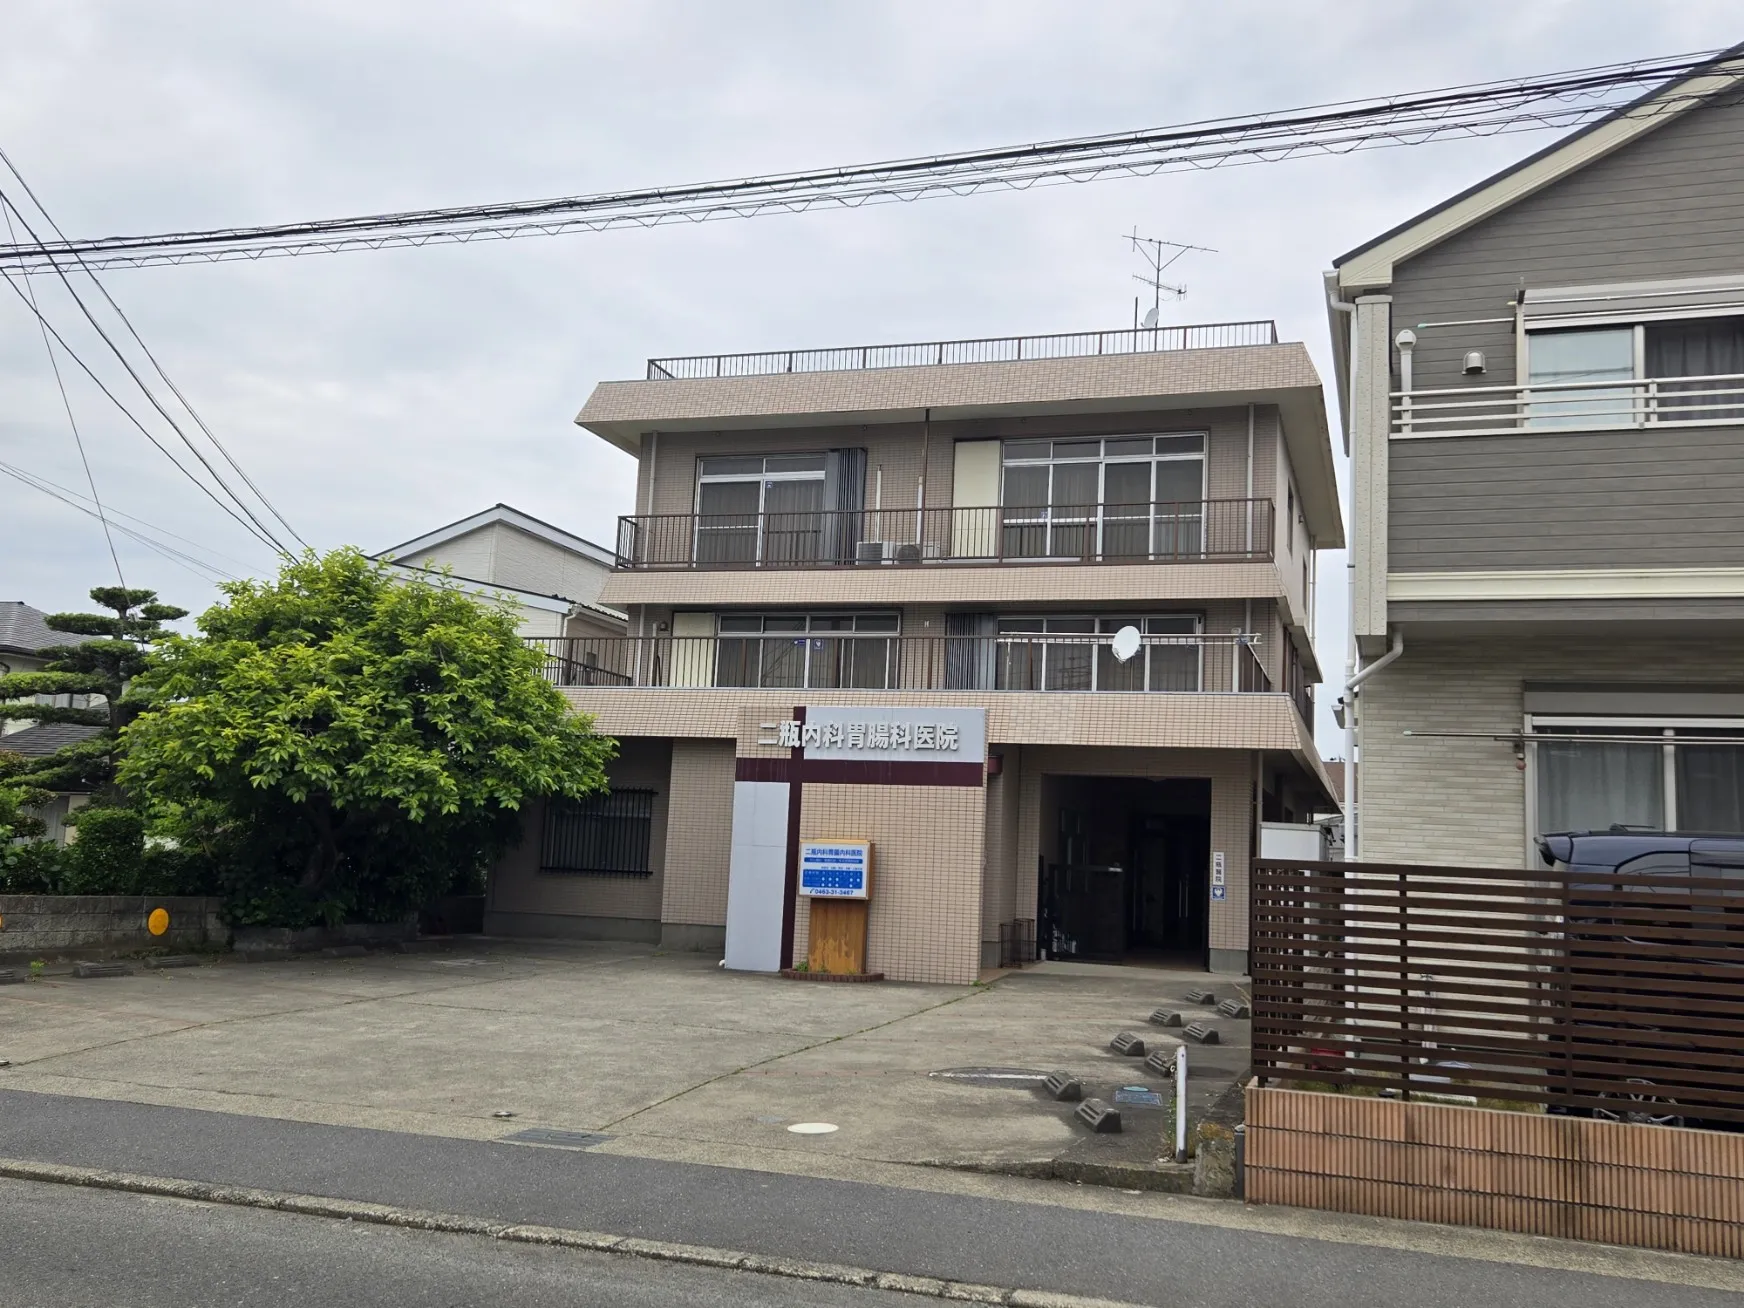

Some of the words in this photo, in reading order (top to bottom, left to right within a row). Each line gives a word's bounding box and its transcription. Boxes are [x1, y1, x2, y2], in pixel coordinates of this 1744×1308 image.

[757, 720, 959, 751] 二瓶内科胃腸科医院
